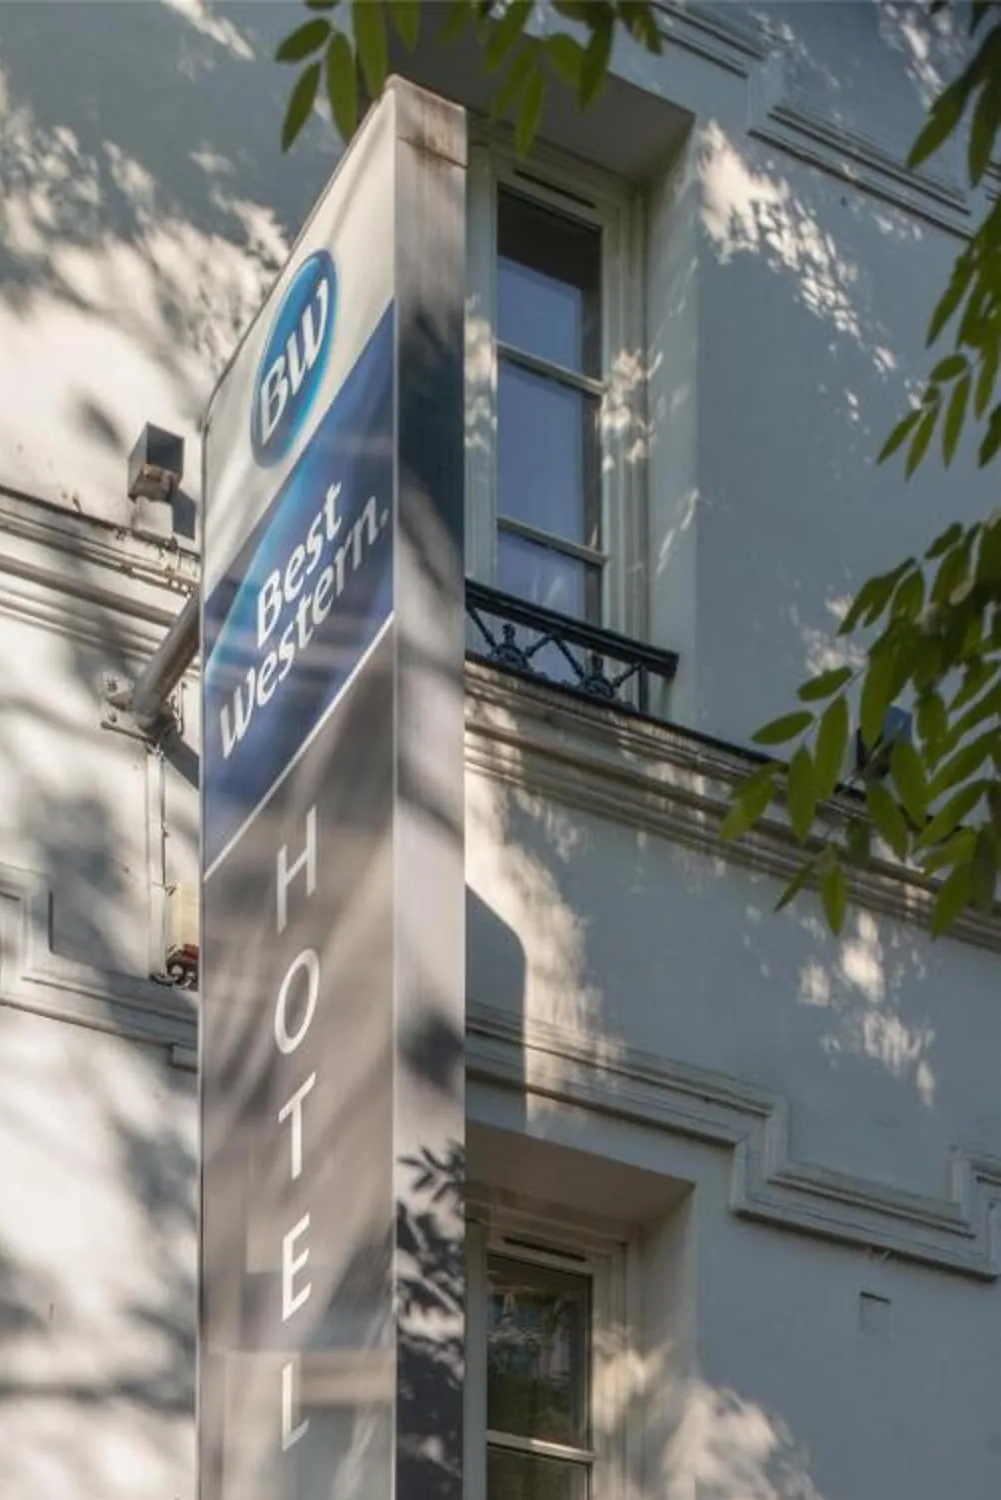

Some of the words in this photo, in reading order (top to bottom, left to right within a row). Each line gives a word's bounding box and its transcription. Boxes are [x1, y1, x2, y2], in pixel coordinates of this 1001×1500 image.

[260, 278, 329, 446] BW
[257, 480, 342, 650] Best
[274, 805, 319, 1453] HOTEL
